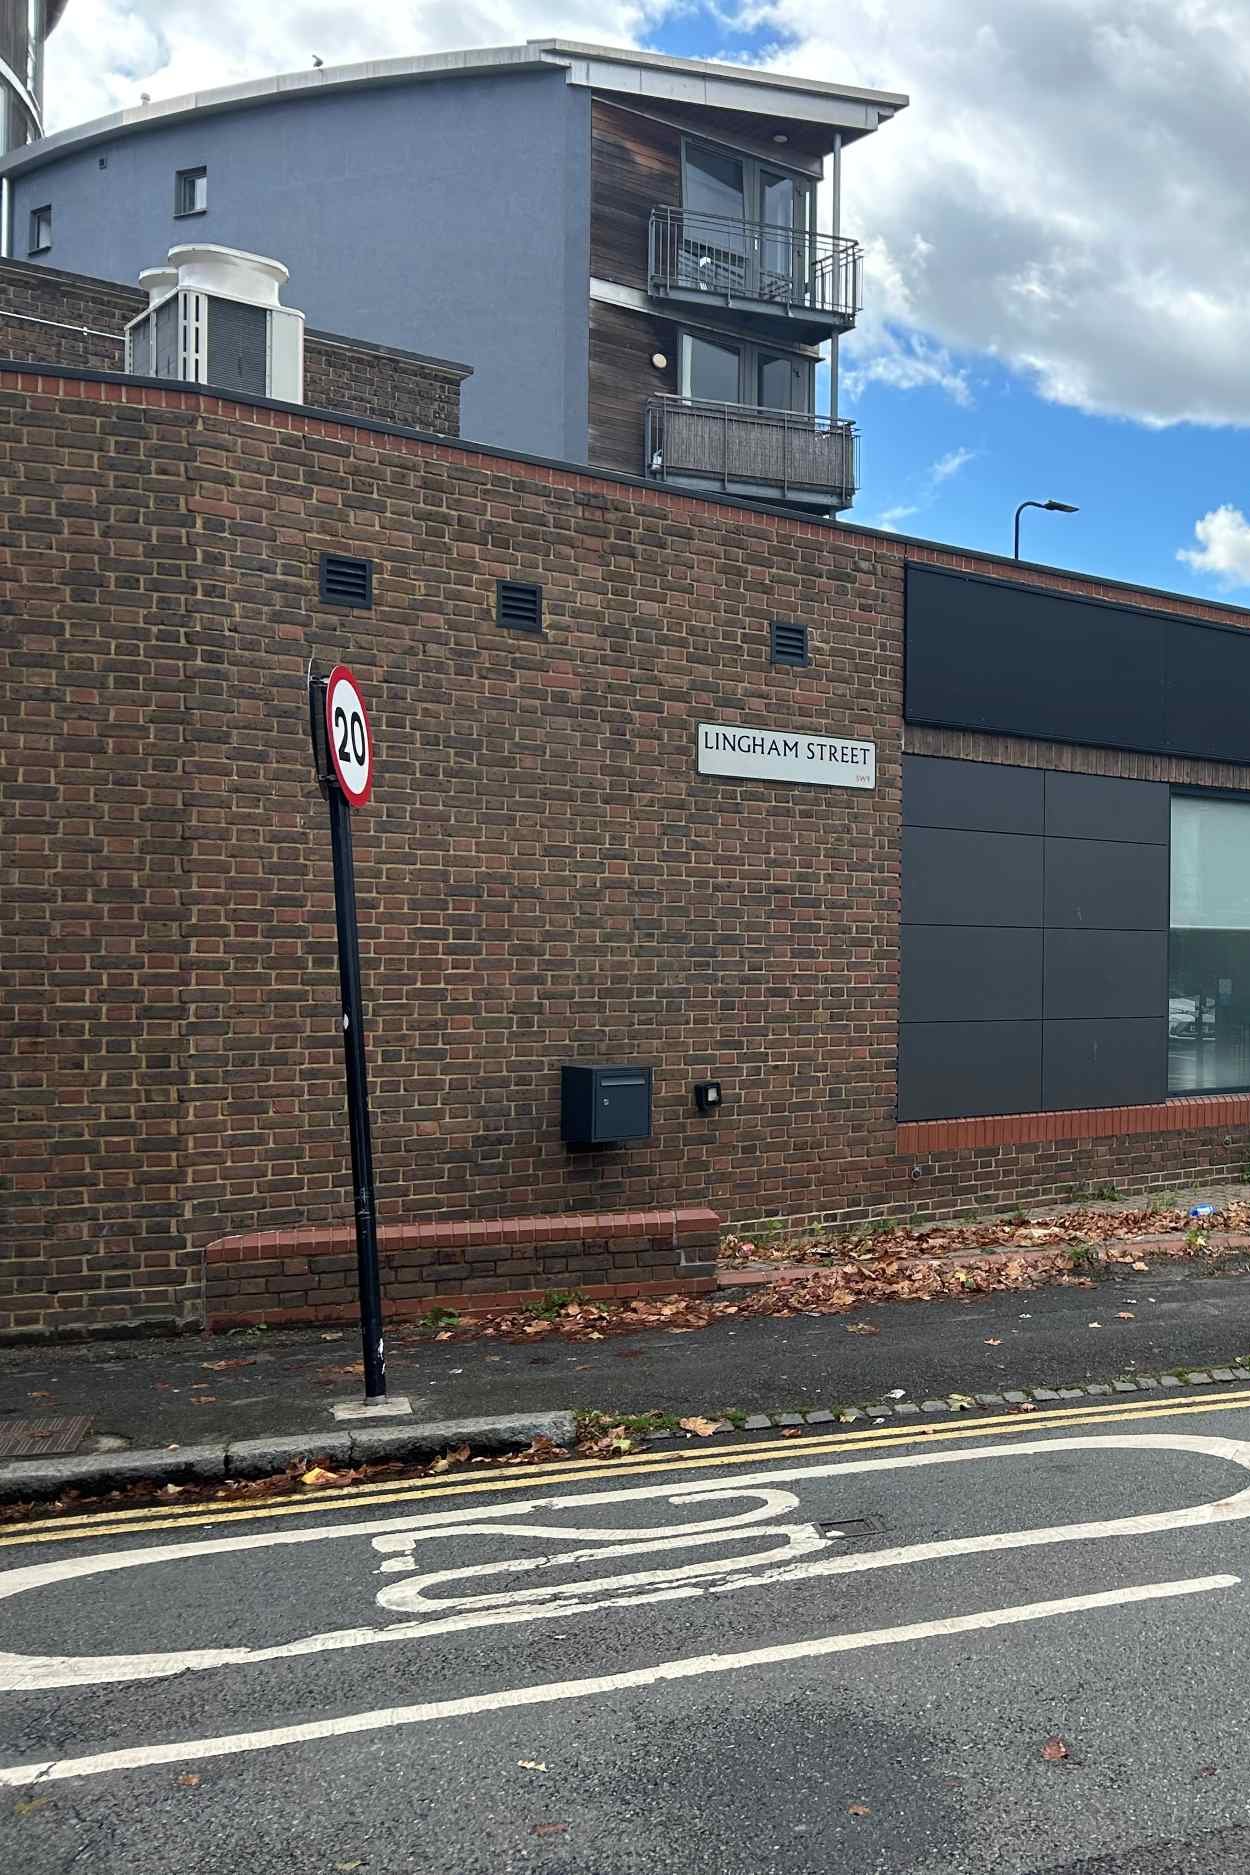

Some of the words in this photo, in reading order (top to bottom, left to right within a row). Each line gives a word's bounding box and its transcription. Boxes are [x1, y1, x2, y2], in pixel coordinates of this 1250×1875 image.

[334, 706, 366, 767] 20
[704, 731, 799, 758] LINGHAM
[806, 742, 871, 765] STREET
[371, 1488, 836, 1613] 20
